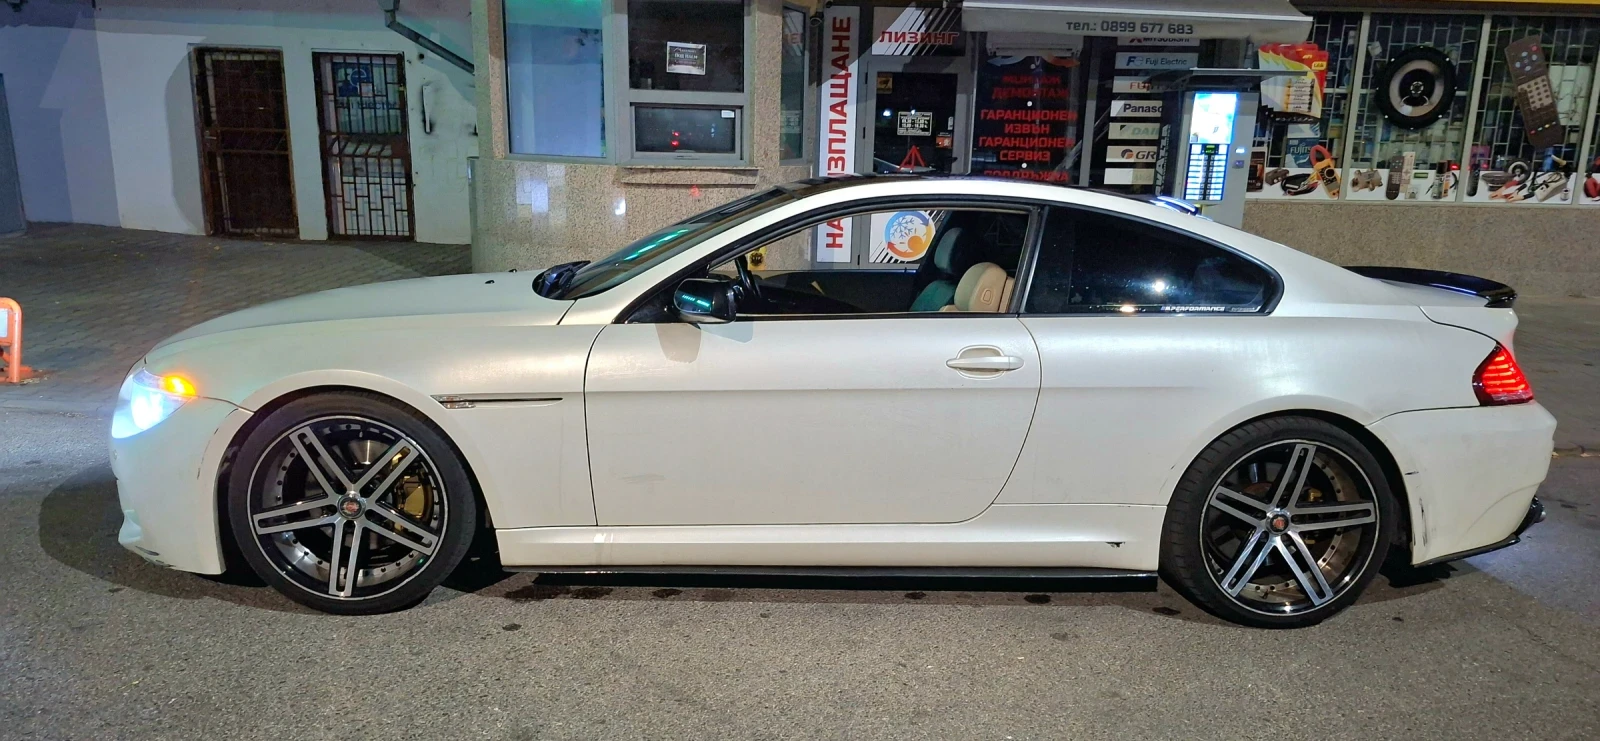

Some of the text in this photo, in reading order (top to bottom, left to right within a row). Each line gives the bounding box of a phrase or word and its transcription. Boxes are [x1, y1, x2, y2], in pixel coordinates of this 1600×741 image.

[1100, 20, 1136, 32] 0899
[1140, 22, 1165, 33] 677
[1167, 23, 1193, 35] 683
[879, 31, 959, 45] ЛИЗИНГ
[1145, 57, 1159, 66] Fuji
[1160, 57, 1187, 65] Electric
[1123, 103, 1163, 113] Panaso
[980, 109, 1078, 121] ГАРАНЦИОНЕН
[1004, 123, 1050, 134] ИЗВЪН
[978, 137, 1075, 148] ГАРАНЦИОНЕН
[999, 150, 1051, 161] СЕРВИЗ
[1136, 151, 1157, 160] GR
